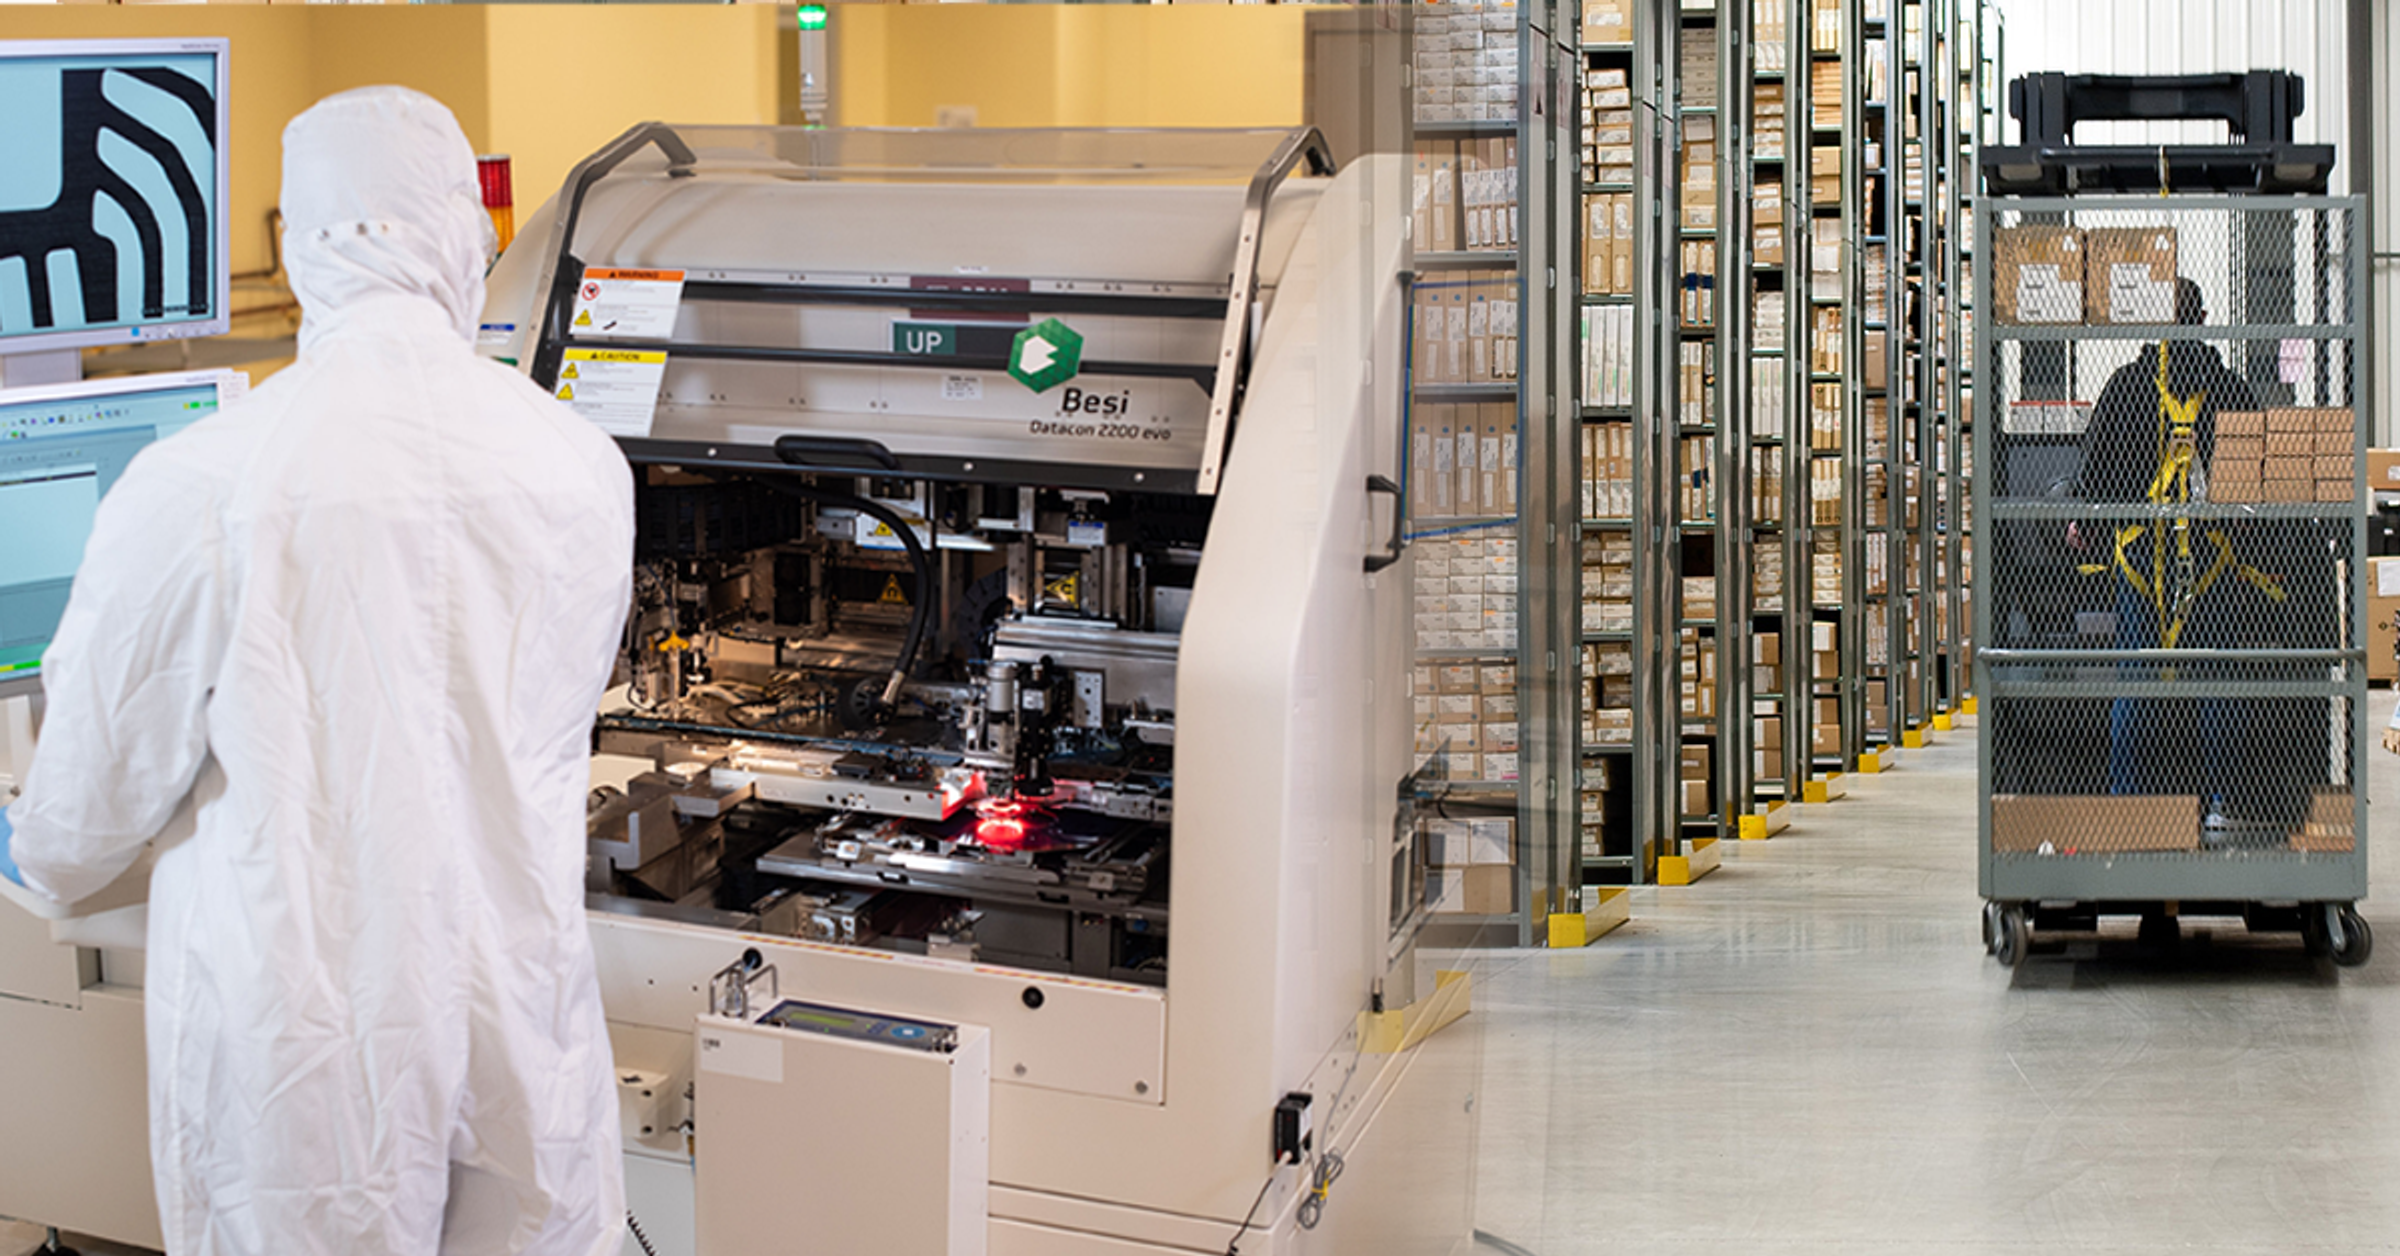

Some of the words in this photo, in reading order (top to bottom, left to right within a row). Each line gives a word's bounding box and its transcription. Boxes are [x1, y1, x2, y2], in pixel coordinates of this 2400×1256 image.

[906, 330, 943, 354] UP
[600, 353, 640, 361] CAUTION
[1061, 386, 1130, 415] Besi
[1029, 420, 1096, 437] Datacon
[1098, 423, 1140, 439] 2200
[1142, 429, 1172, 441] evo
